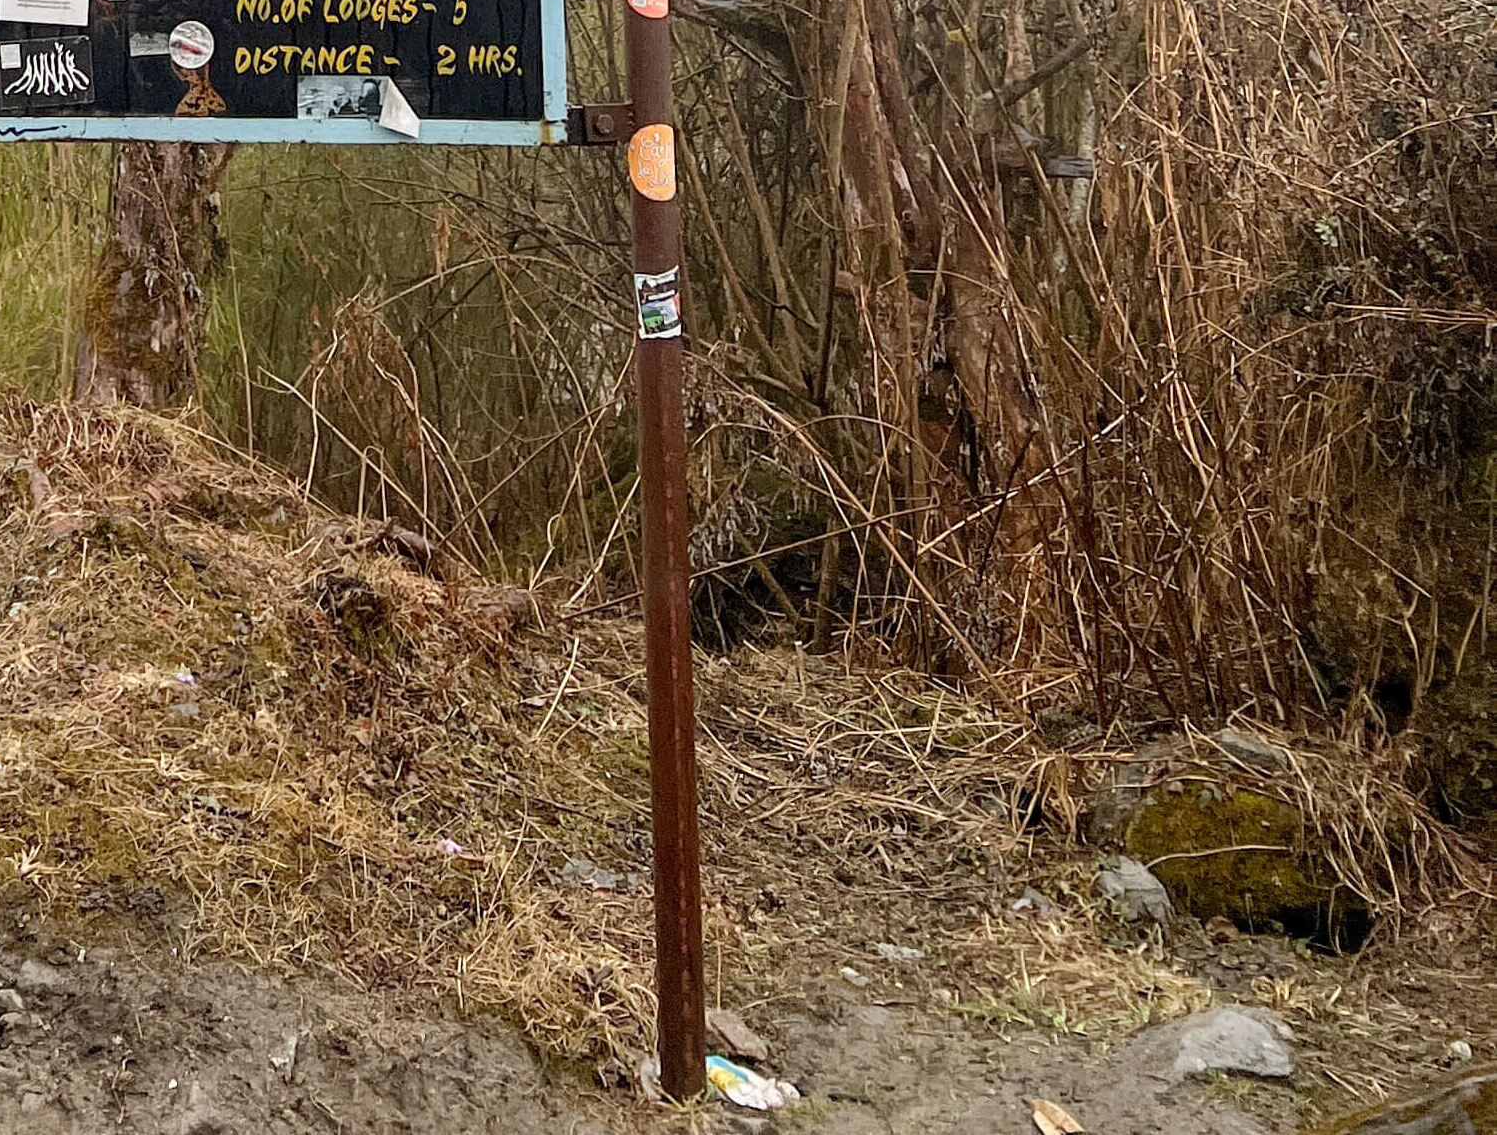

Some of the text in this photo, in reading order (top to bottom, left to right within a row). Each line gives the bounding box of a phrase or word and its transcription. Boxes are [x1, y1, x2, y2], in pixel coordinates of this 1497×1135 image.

[234, 44, 522, 76] DISTANCE 2 HRS.
